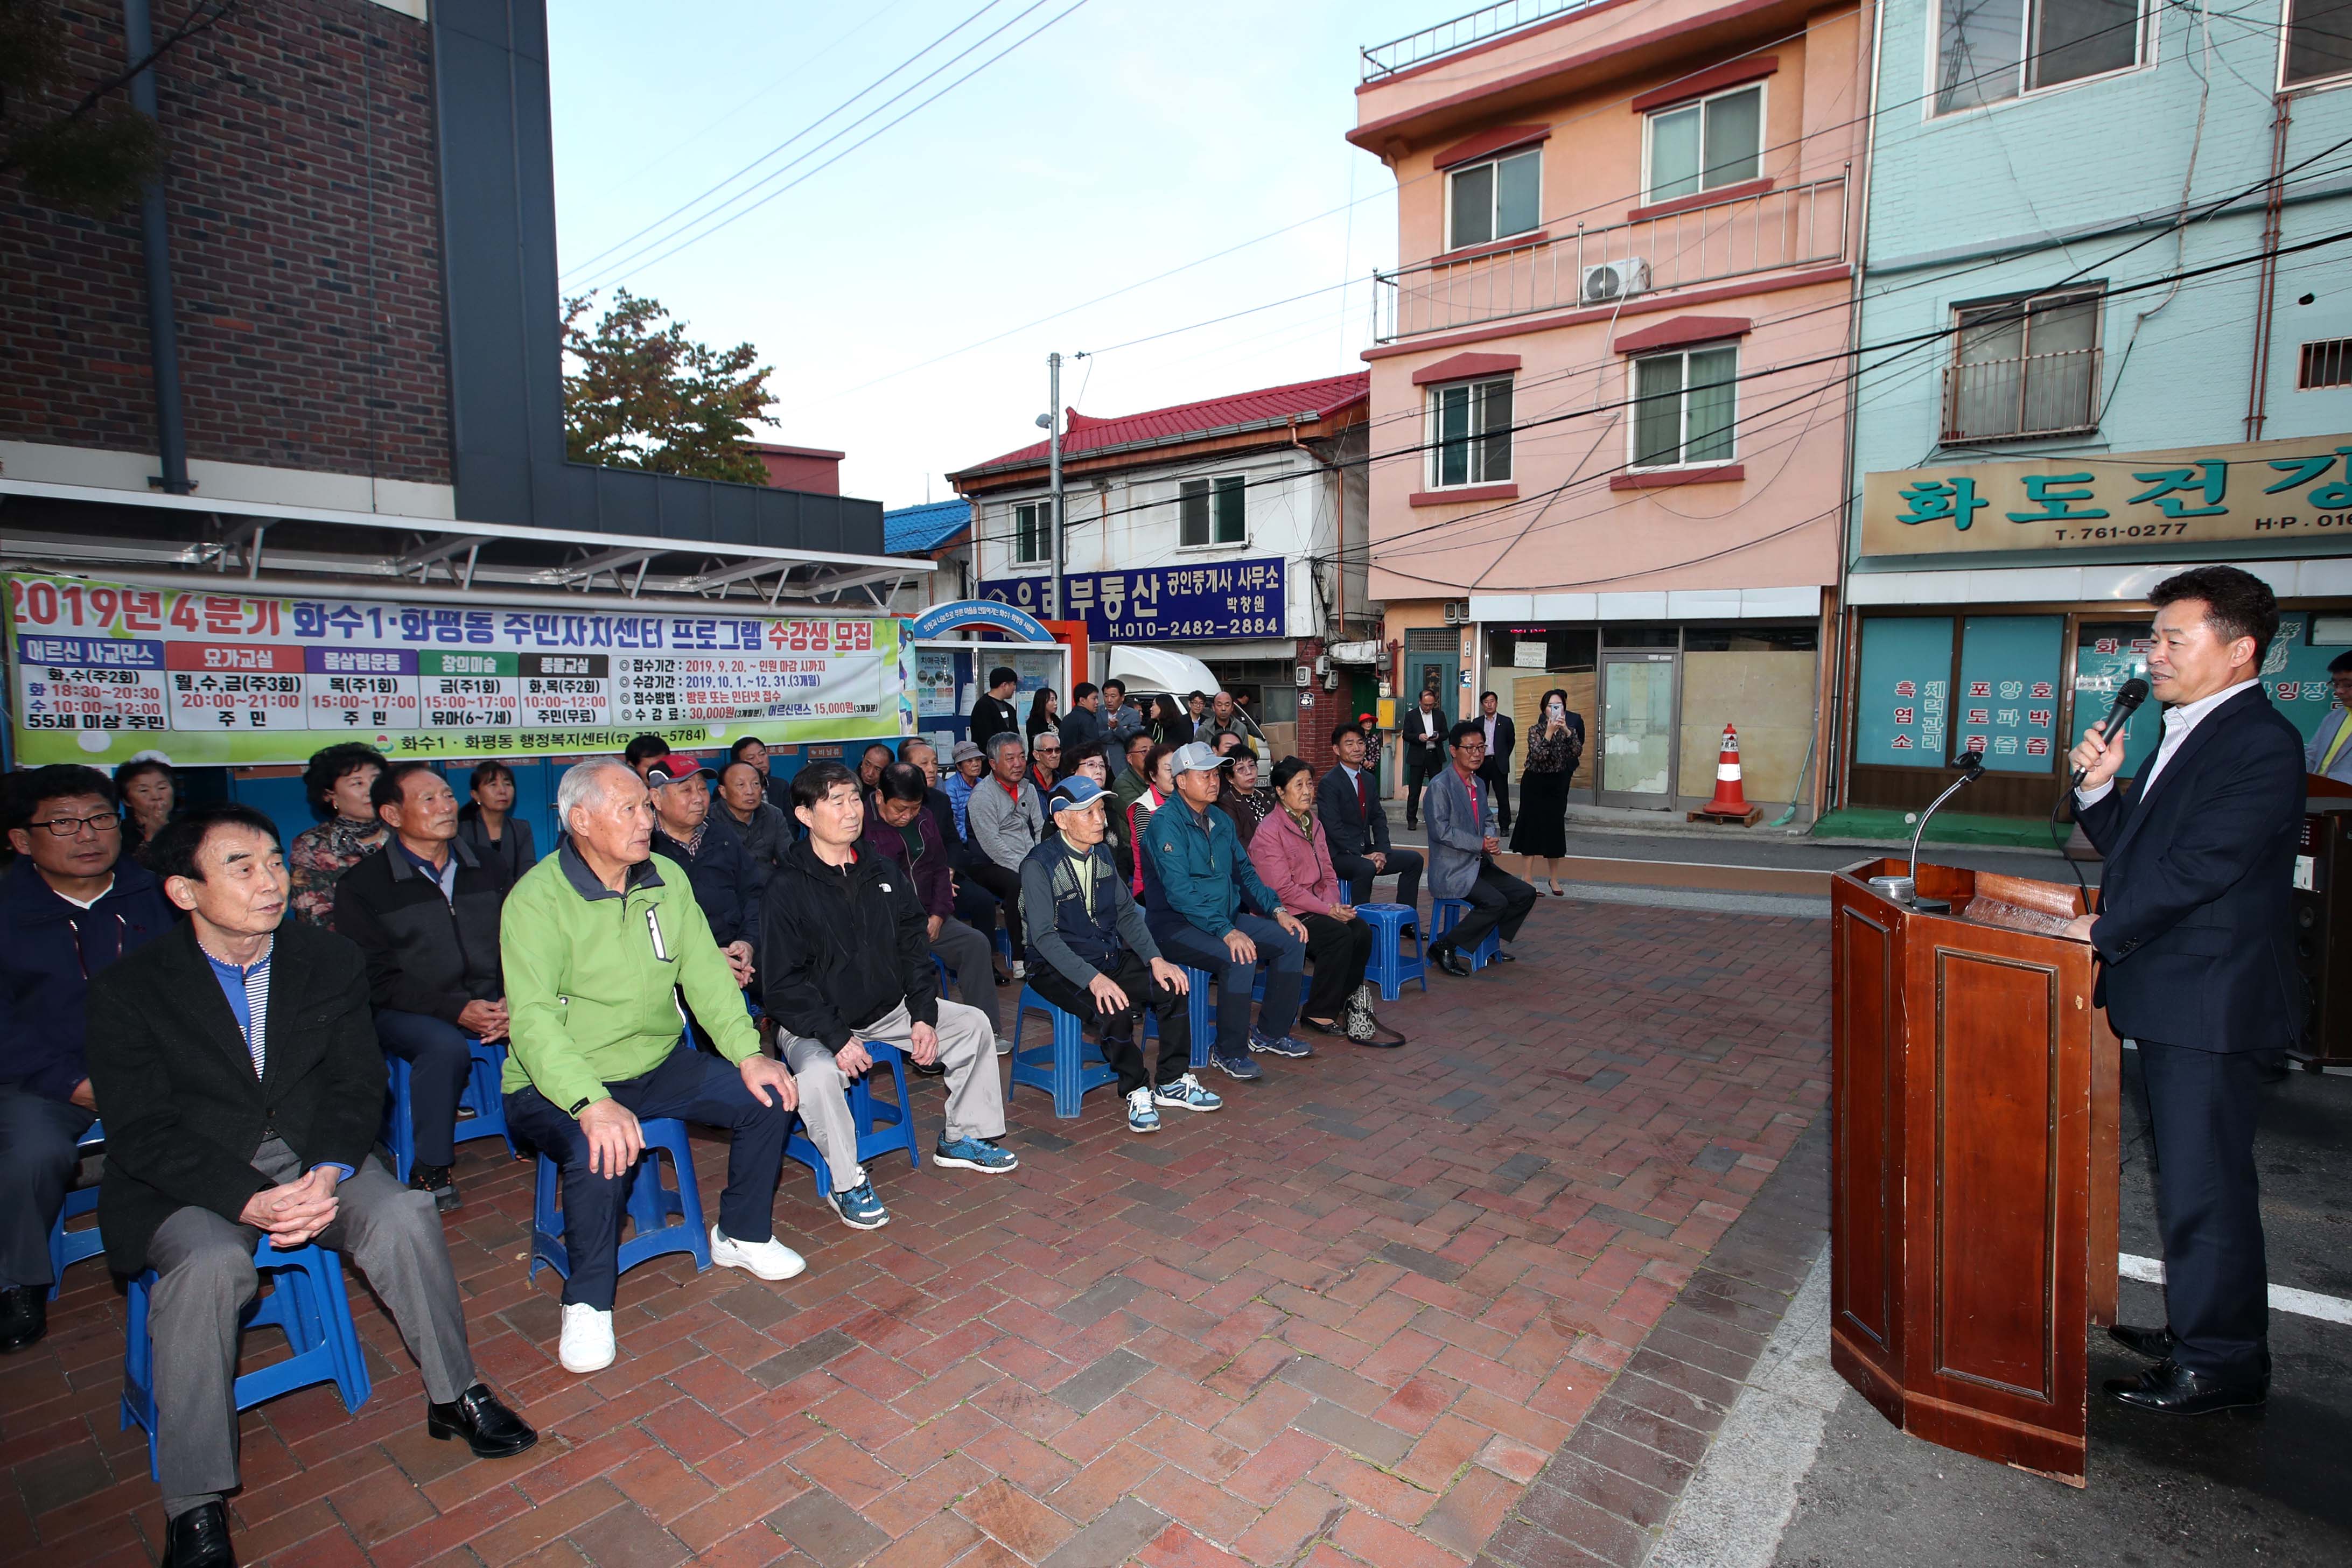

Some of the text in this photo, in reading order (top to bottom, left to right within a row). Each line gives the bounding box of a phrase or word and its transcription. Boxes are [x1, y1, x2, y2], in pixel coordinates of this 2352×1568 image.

[1167, 565, 1279, 596] 공인중개사 사무소
[1227, 595, 1264, 613] 박창원
[11, 580, 162, 631] 2019년
[170, 594, 280, 636] 4분기
[503, 613, 663, 649] 주민자치센터
[672, 619, 762, 650] 프로그램
[768, 621, 829, 651] 수강생
[835, 622, 871, 651] 모집
[1109, 618, 1277, 638] H.010-2482-2884
[27, 639, 155, 665] 어르신 사교댄스
[204, 648, 273, 669] 요가교실
[324, 652, 401, 671] 몸살림운동
[442, 654, 497, 673] 창의미술
[540, 657, 589, 674] 풍물교실
[633, 659, 675, 673] 접수기간
[759, 660, 777, 673] 인원
[780, 660, 797, 673] 마감
[800, 660, 825, 672] 시까지
[47, 668, 140, 684] 화,수(주2회)
[633, 675, 675, 689] 수강기간
[29, 682, 160, 699] 화 18:30~20:30
[330, 677, 398, 694] 목(주1회)
[439, 678, 500, 694] 금(주1회)
[529, 679, 600, 695] 화,목(주2회)
[181, 694, 299, 708] 20:00~21:00
[312, 696, 416, 709] 15:00~17:00
[424, 696, 516, 709] 15:00~17:00
[523, 696, 606, 708] 10:00~12:00
[633, 691, 675, 705] 접수방법
[686, 691, 707, 704] 방문
[710, 691, 730, 704] 또는
[731, 690, 761, 703] 인터넷
[763, 690, 781, 703] 접수
[30, 699, 160, 715] 수 10:00~12:00
[768, 703, 812, 717] 어르신댄스
[29, 714, 165, 730] 55세 이상 주민
[431, 710, 512, 725] 유아(6~7세)
[537, 709, 597, 724] 주민(무료)
[1891, 681, 1916, 750] 흑염소
[1921, 681, 1946, 752] 체력관리
[1965, 682, 1991, 753] 포도즙
[1994, 681, 2023, 754] 양파즙
[2025, 682, 2053, 756] 호박즙
[465, 734, 513, 750] 화평동
